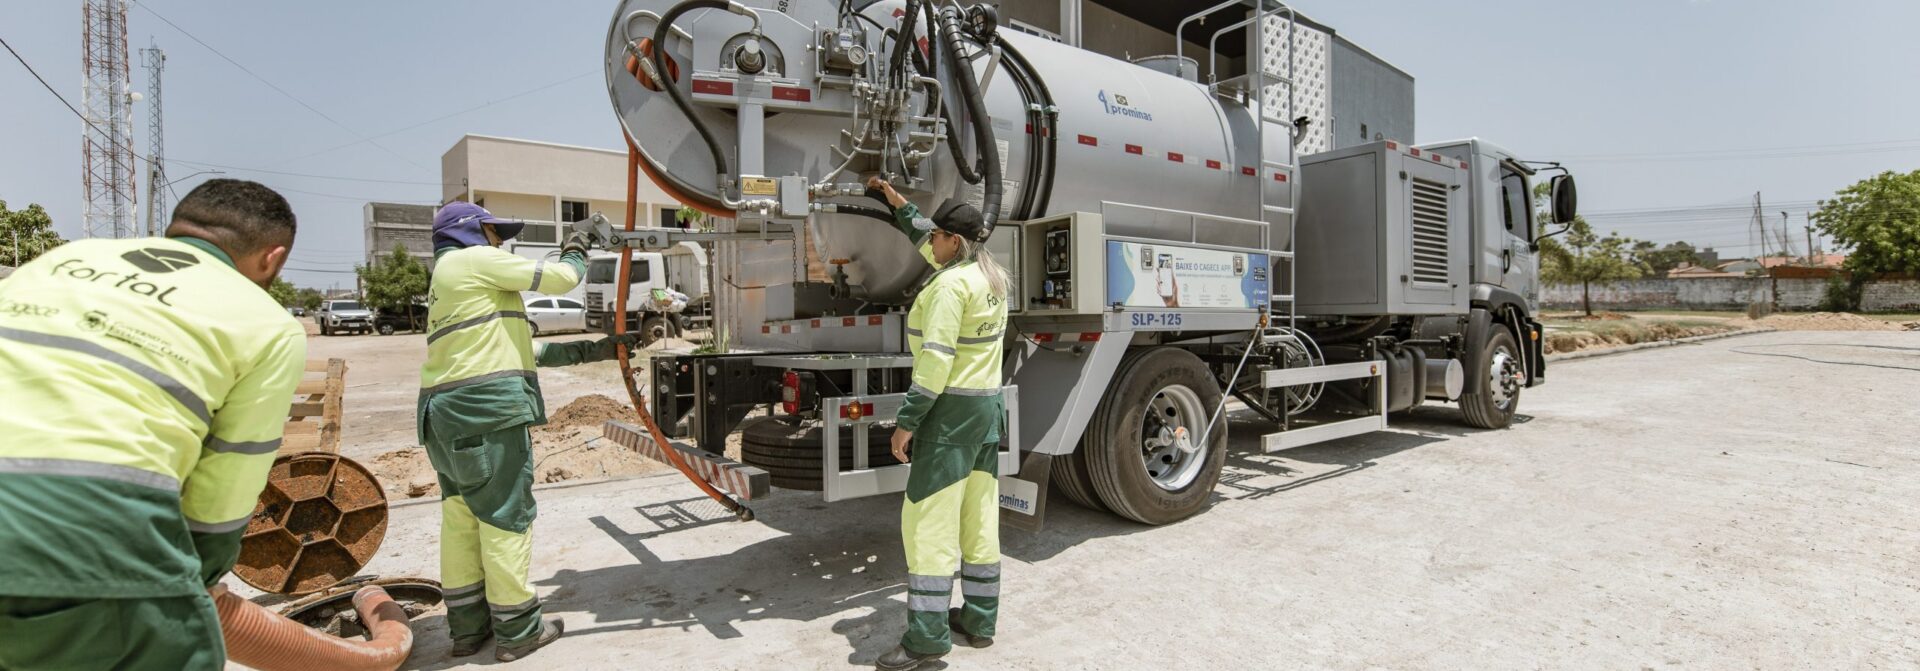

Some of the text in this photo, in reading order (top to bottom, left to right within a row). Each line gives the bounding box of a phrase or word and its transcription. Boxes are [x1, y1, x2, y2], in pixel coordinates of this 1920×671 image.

[1111, 105, 1152, 121] prominas
[1175, 262, 1193, 270] BAIXE
[1199, 263, 1219, 272] CAGECE
[51, 259, 178, 307] fortal
[1132, 312, 1182, 327] SLP-125
